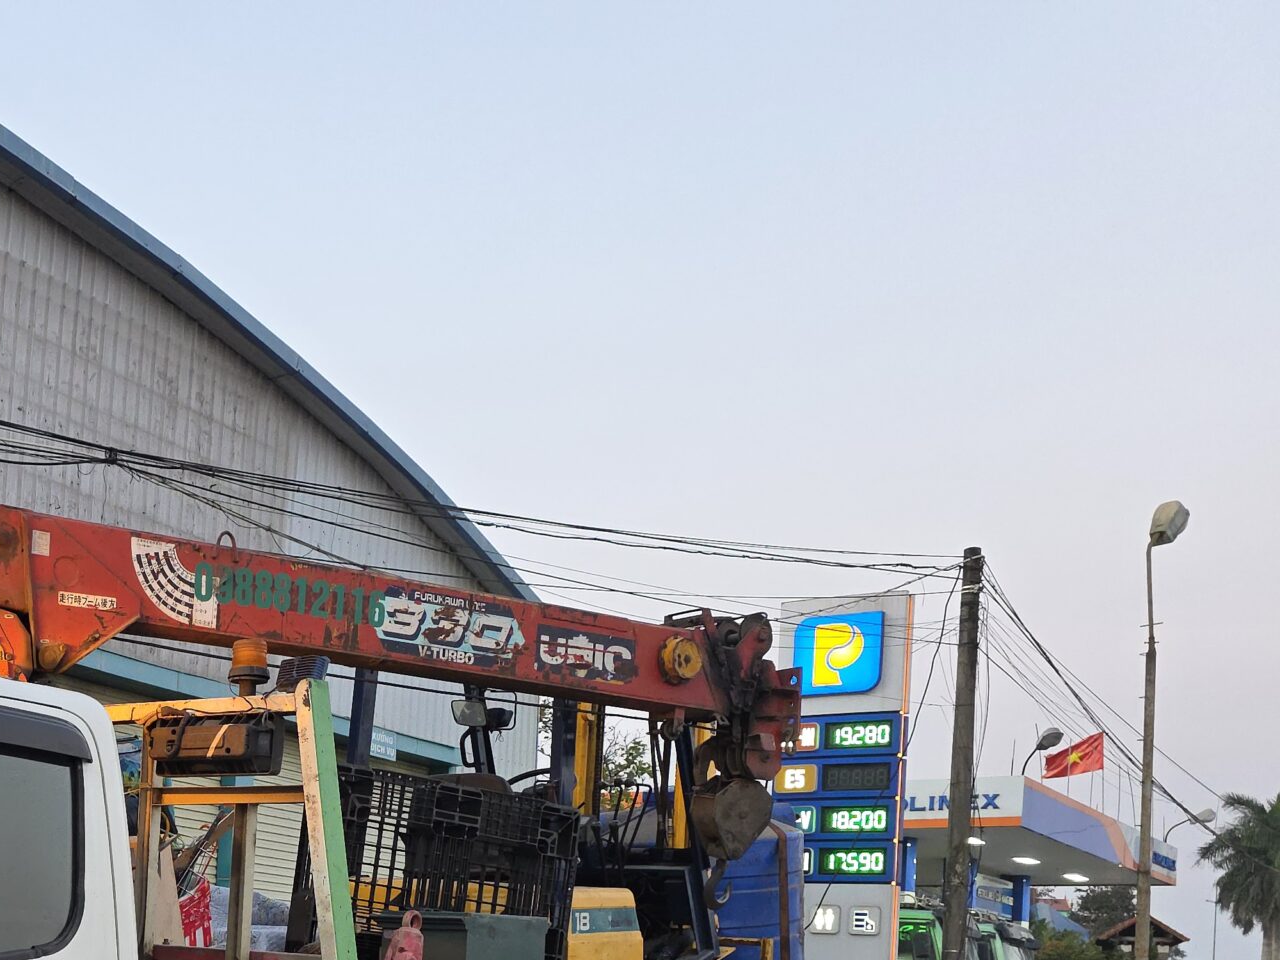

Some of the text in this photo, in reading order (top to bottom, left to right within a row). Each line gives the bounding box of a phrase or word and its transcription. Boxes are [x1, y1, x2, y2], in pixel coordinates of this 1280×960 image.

[414, 591, 465, 608] FURUKAWA
[418, 644, 475, 666] V-TURBO
[784, 768, 806, 789] E5
